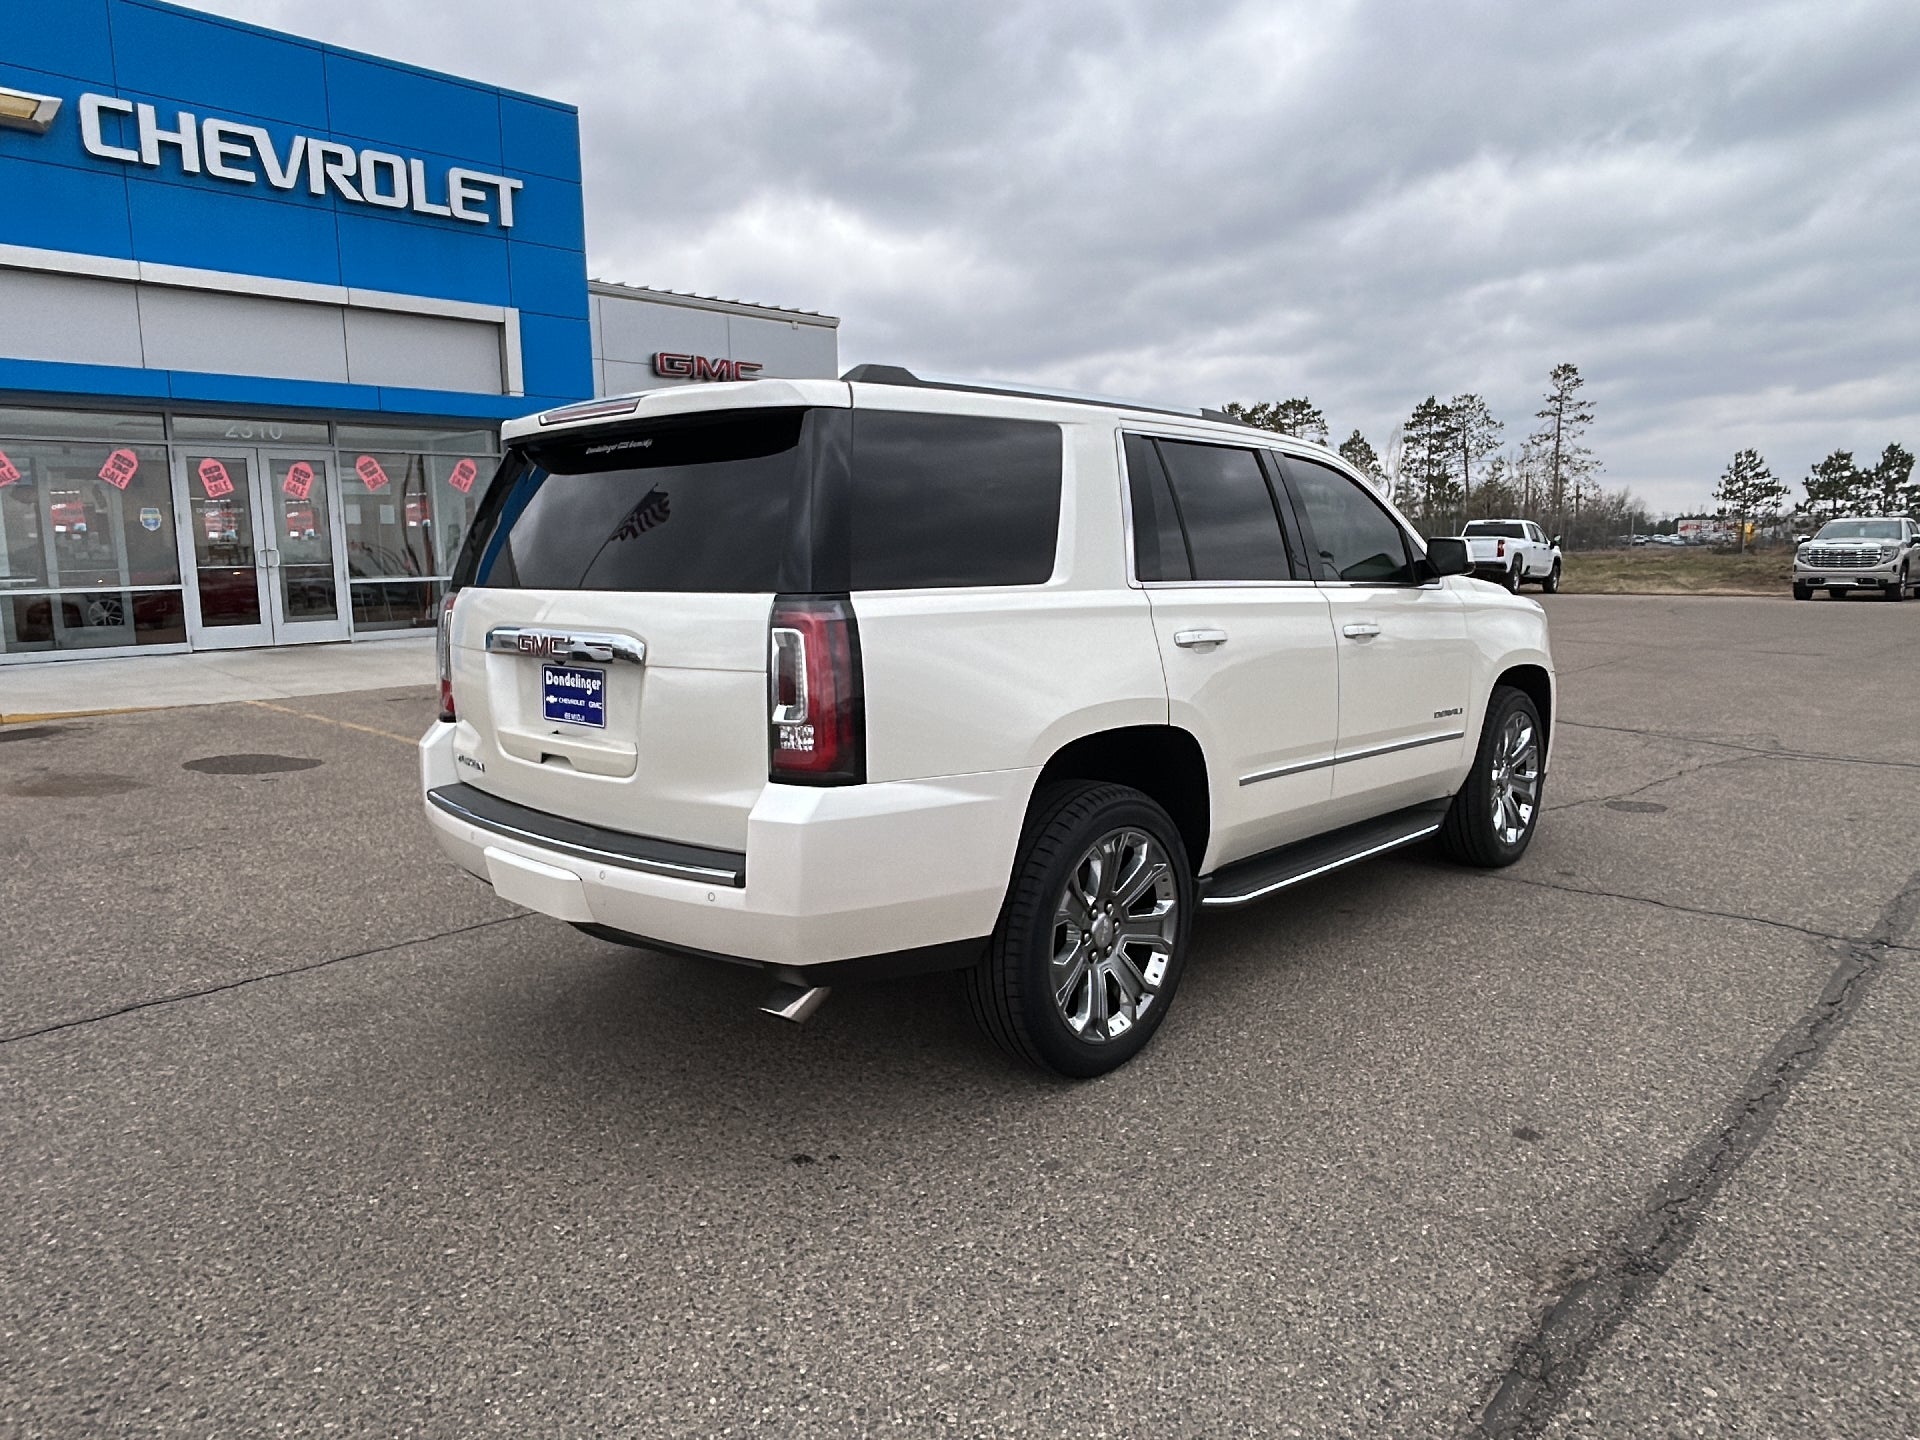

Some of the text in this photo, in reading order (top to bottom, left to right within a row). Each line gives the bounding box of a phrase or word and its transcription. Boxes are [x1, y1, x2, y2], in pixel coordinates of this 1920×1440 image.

[78, 92, 523, 228] CHEVROLET
[653, 352, 763, 381] GMC
[101, 467, 127, 488] SALE
[208, 480, 231, 496] SALE
[518, 634, 571, 656] GMC
[545, 670, 602, 696] Dondelinger
[588, 700, 603, 710] GMC
